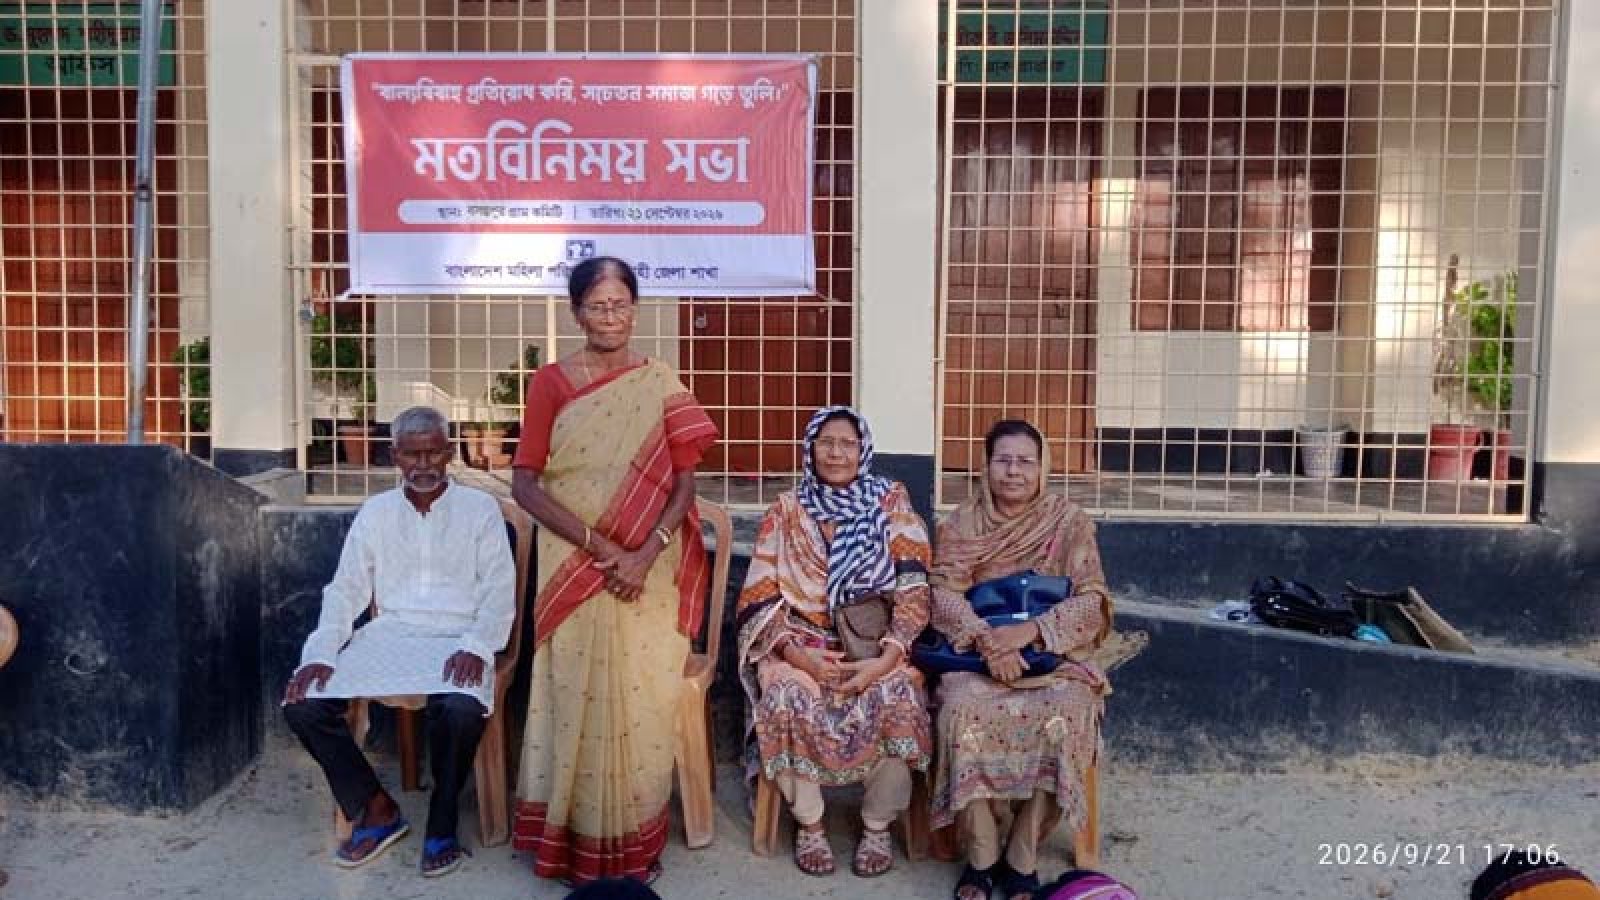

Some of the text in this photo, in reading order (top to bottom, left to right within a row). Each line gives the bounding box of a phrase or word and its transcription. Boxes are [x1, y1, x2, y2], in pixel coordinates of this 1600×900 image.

[466, 77, 535, 105] প্রতিরোধ
[538, 77, 577, 104] করি,
[581, 84, 642, 104] সচেতন
[645, 84, 696, 102] সমাজ
[701, 84, 735, 104] গড়ে
[411, 119, 751, 185] মতবিনিময় সভা
[627, 207, 642, 220] ২১
[445, 265, 503, 280] বাংলাদেশ
[506, 262, 544, 280] মহিলা
[547, 262, 572, 280] পরি
[653, 266, 686, 281] জেলা
[689, 267, 719, 280] শাখা
